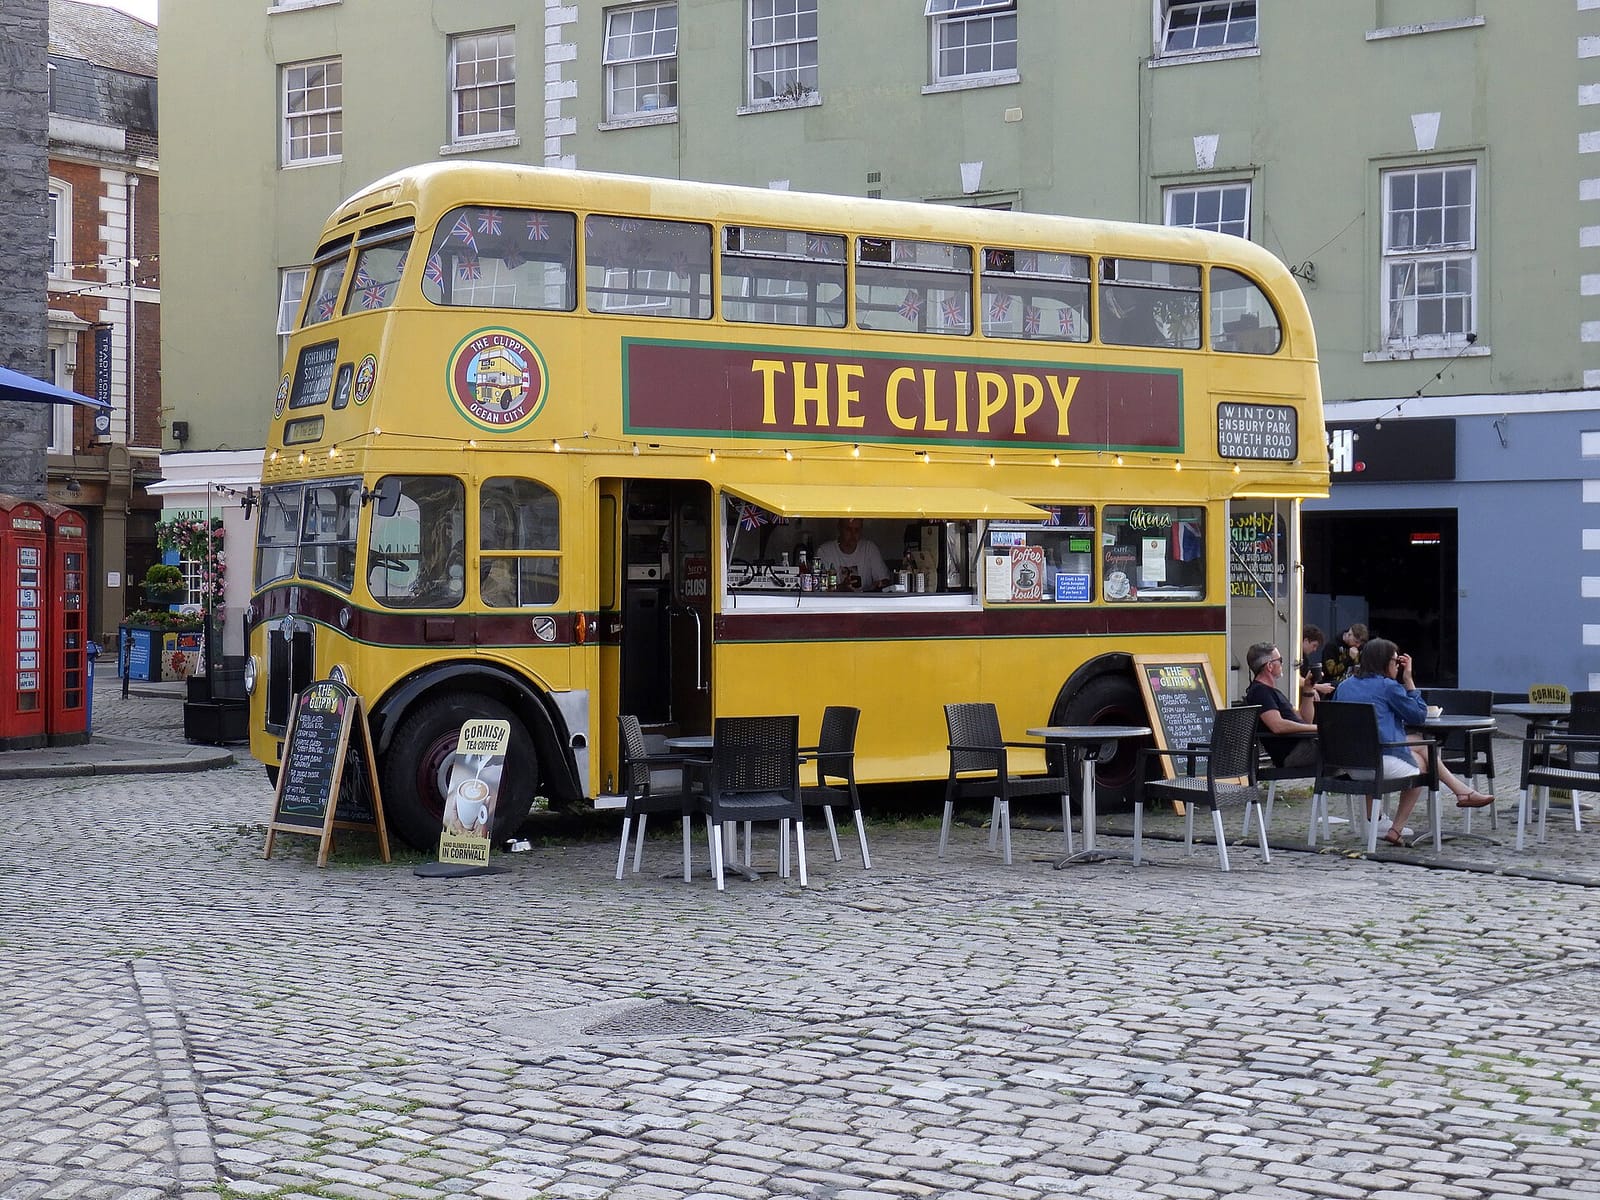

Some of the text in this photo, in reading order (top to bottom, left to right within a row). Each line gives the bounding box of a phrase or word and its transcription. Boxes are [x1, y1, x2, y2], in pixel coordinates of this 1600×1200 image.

[471, 336, 526, 354] THE CLIPPY
[340, 367, 351, 399] 2
[752, 359, 1081, 436] THE CLIPPY
[470, 403, 525, 422] OCEAN CITY
[1225, 406, 1288, 421] WINTON
[1219, 419, 1291, 434] ENSBURY PARK
[1219, 432, 1292, 447] HOWETH ROAD
[1221, 445, 1290, 459] BROOK ROAD
[178, 511, 204, 520] MINT
[1131, 510, 1170, 528] Menu
[1011, 549, 1041, 563] Coffee
[1164, 666, 1182, 677] THE
[1160, 676, 1192, 687] CLIPPY
[317, 684, 334, 697] THE
[1532, 688, 1566, 702] CORNISH
[309, 697, 338, 710] CLIPPY
[464, 725, 506, 742] CORNISH
[466, 740, 498, 751] TEA COFFEE
[442, 848, 486, 861] IN CORNWALL
